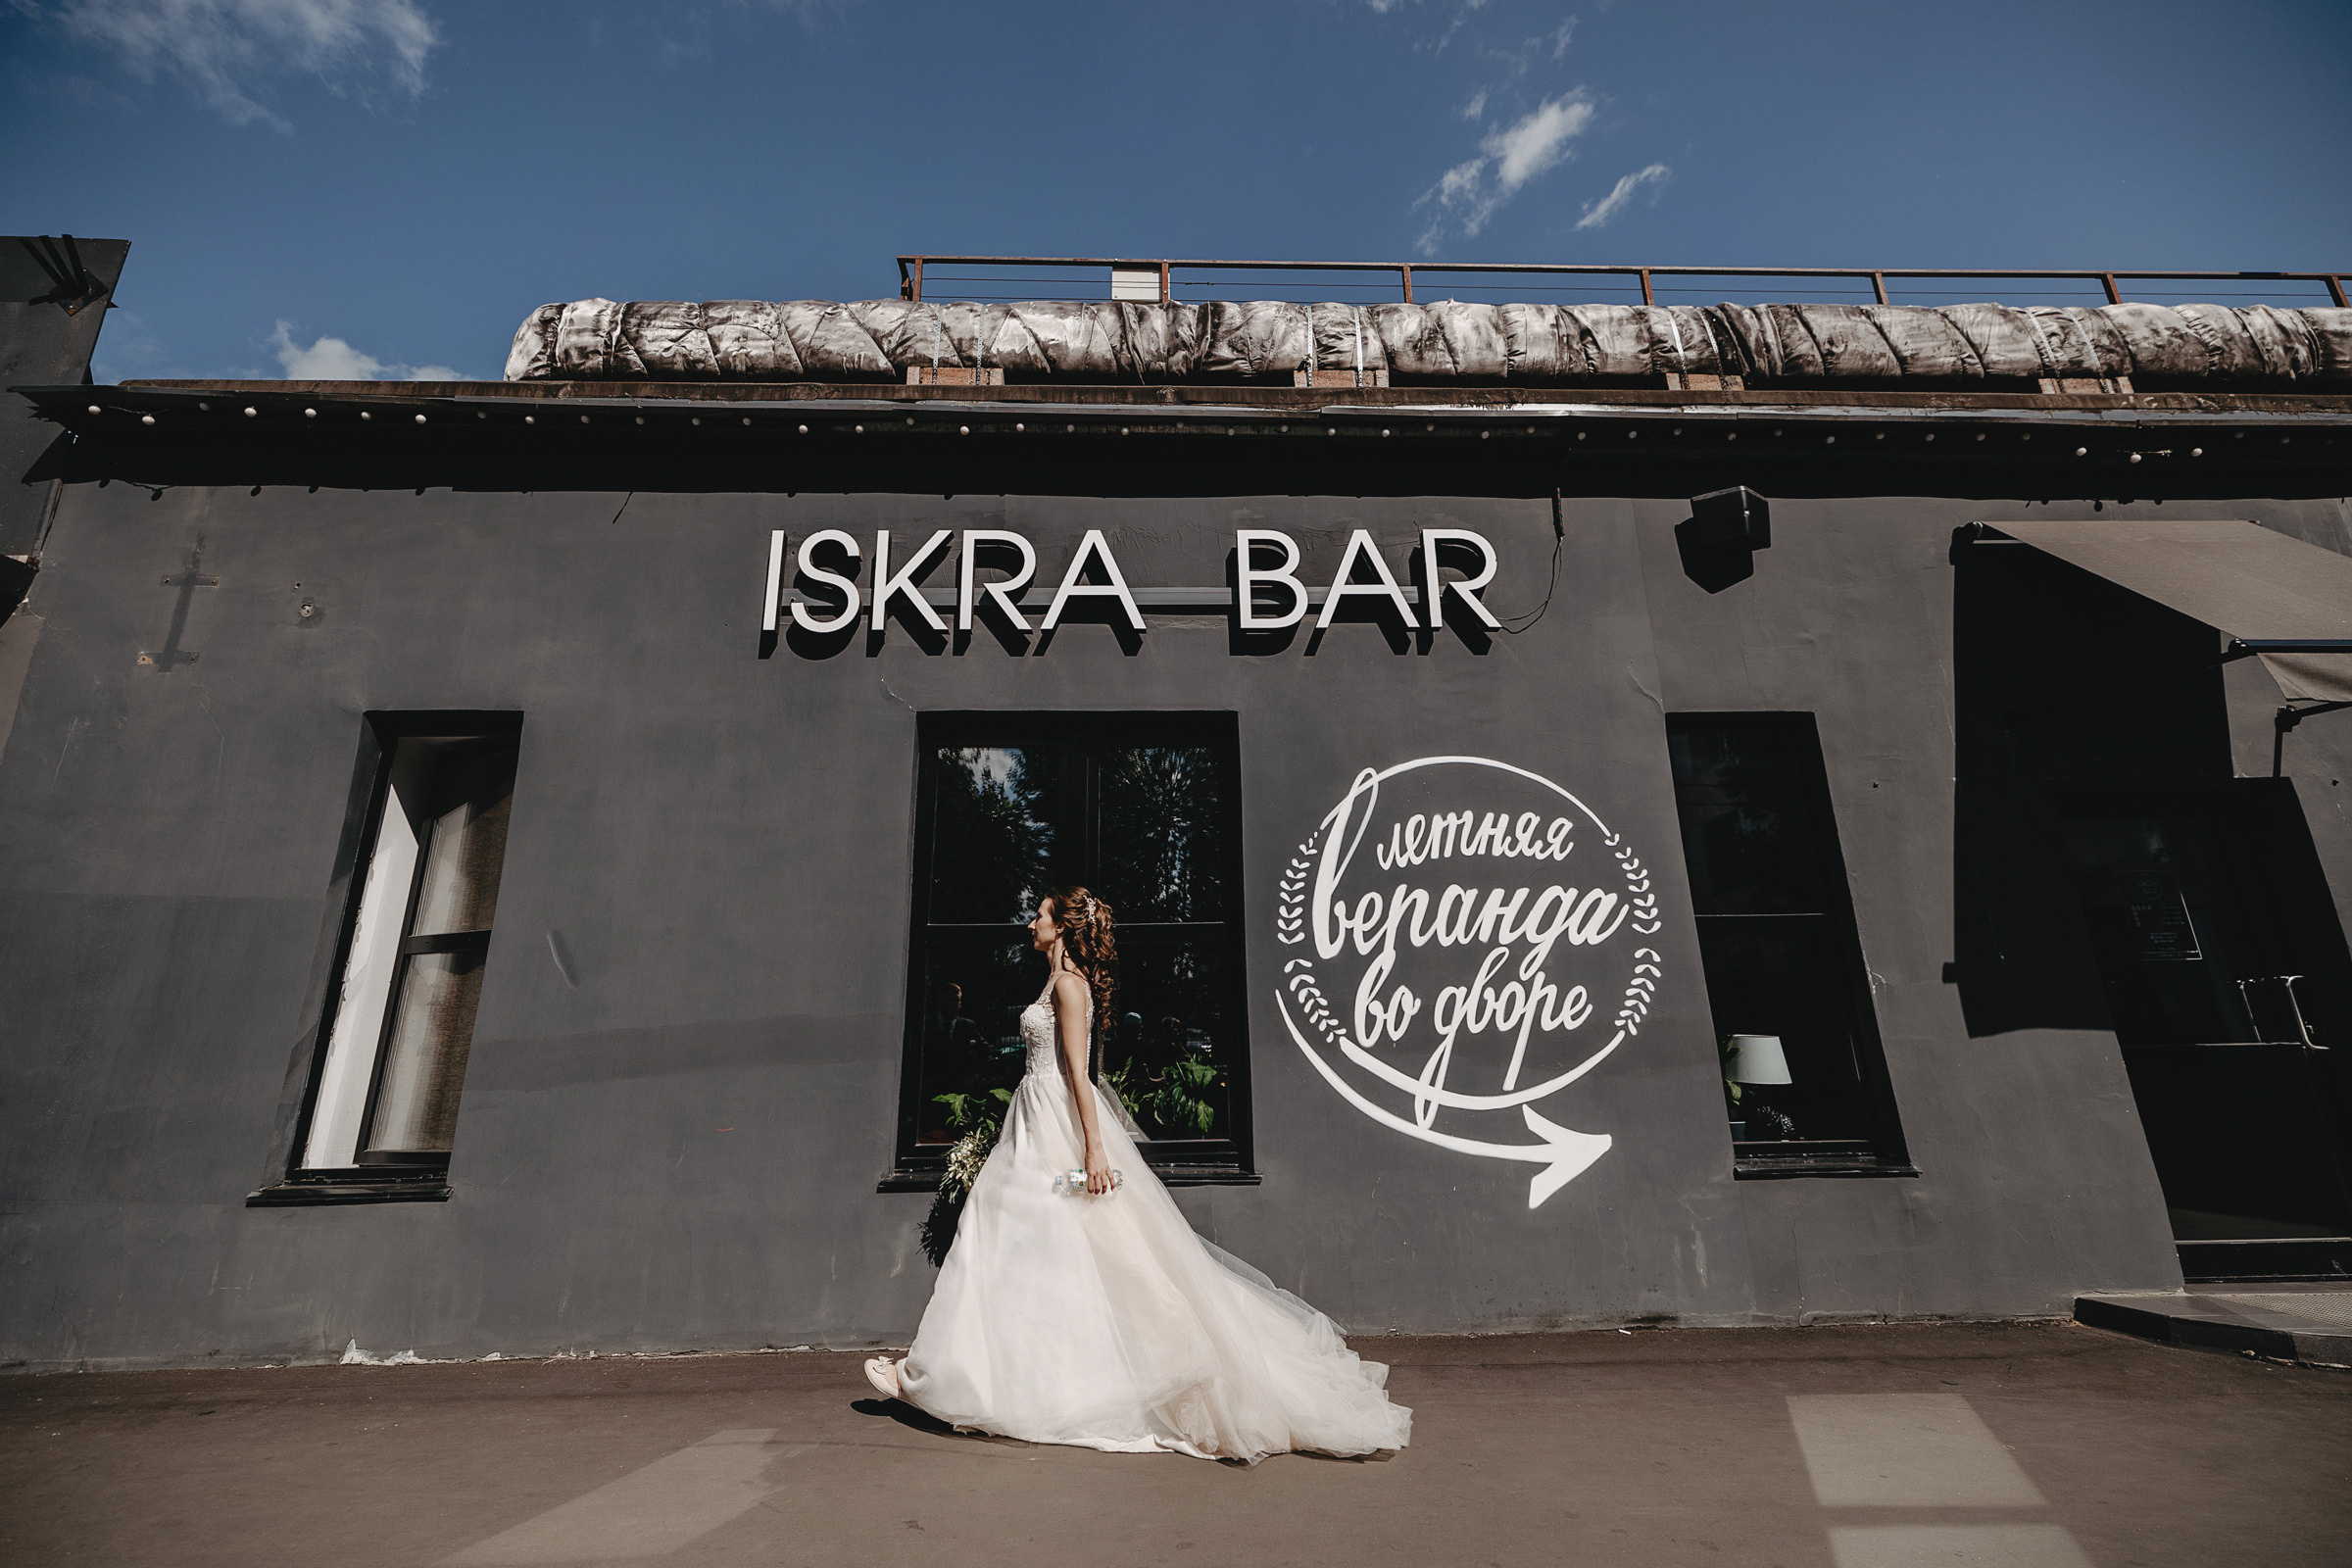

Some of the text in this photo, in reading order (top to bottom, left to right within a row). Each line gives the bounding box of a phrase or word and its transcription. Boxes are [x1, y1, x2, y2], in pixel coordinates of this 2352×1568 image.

[761, 528, 1501, 632] ISKRA BAR
[1376, 809, 1574, 871] летняя
[1354, 947, 1592, 1129] во дворе
